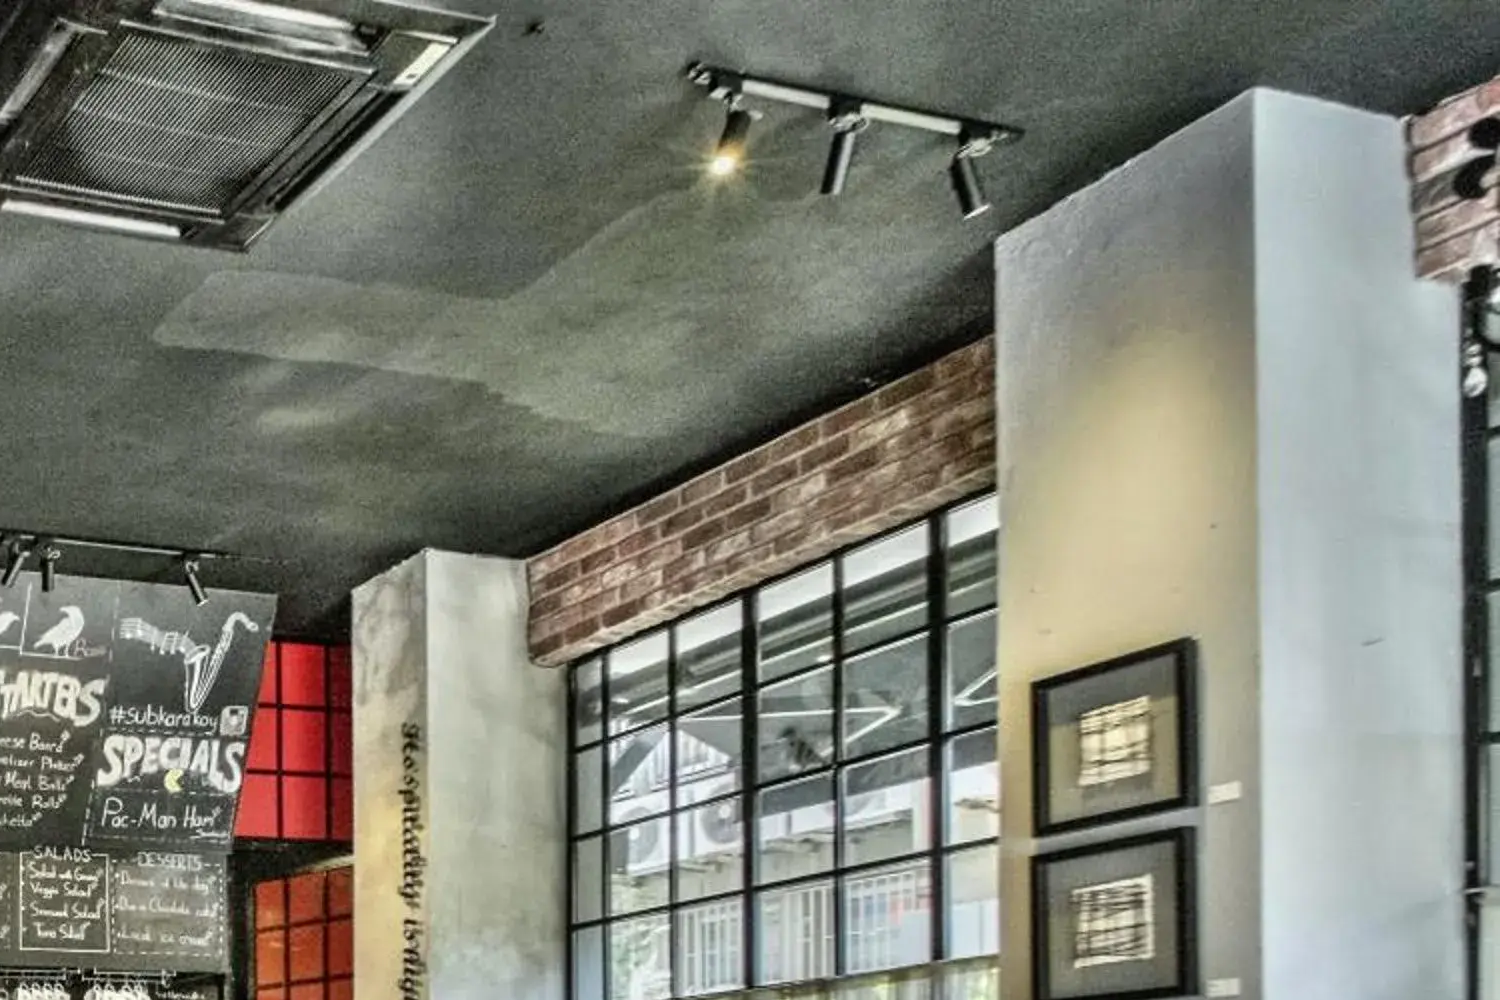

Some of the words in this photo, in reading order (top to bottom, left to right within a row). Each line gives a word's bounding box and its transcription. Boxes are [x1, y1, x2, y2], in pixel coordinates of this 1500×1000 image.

[97, 733, 245, 794] SPECIALS
[102, 796, 178, 829] Pac-Man
[33, 845, 93, 863] SALADS
